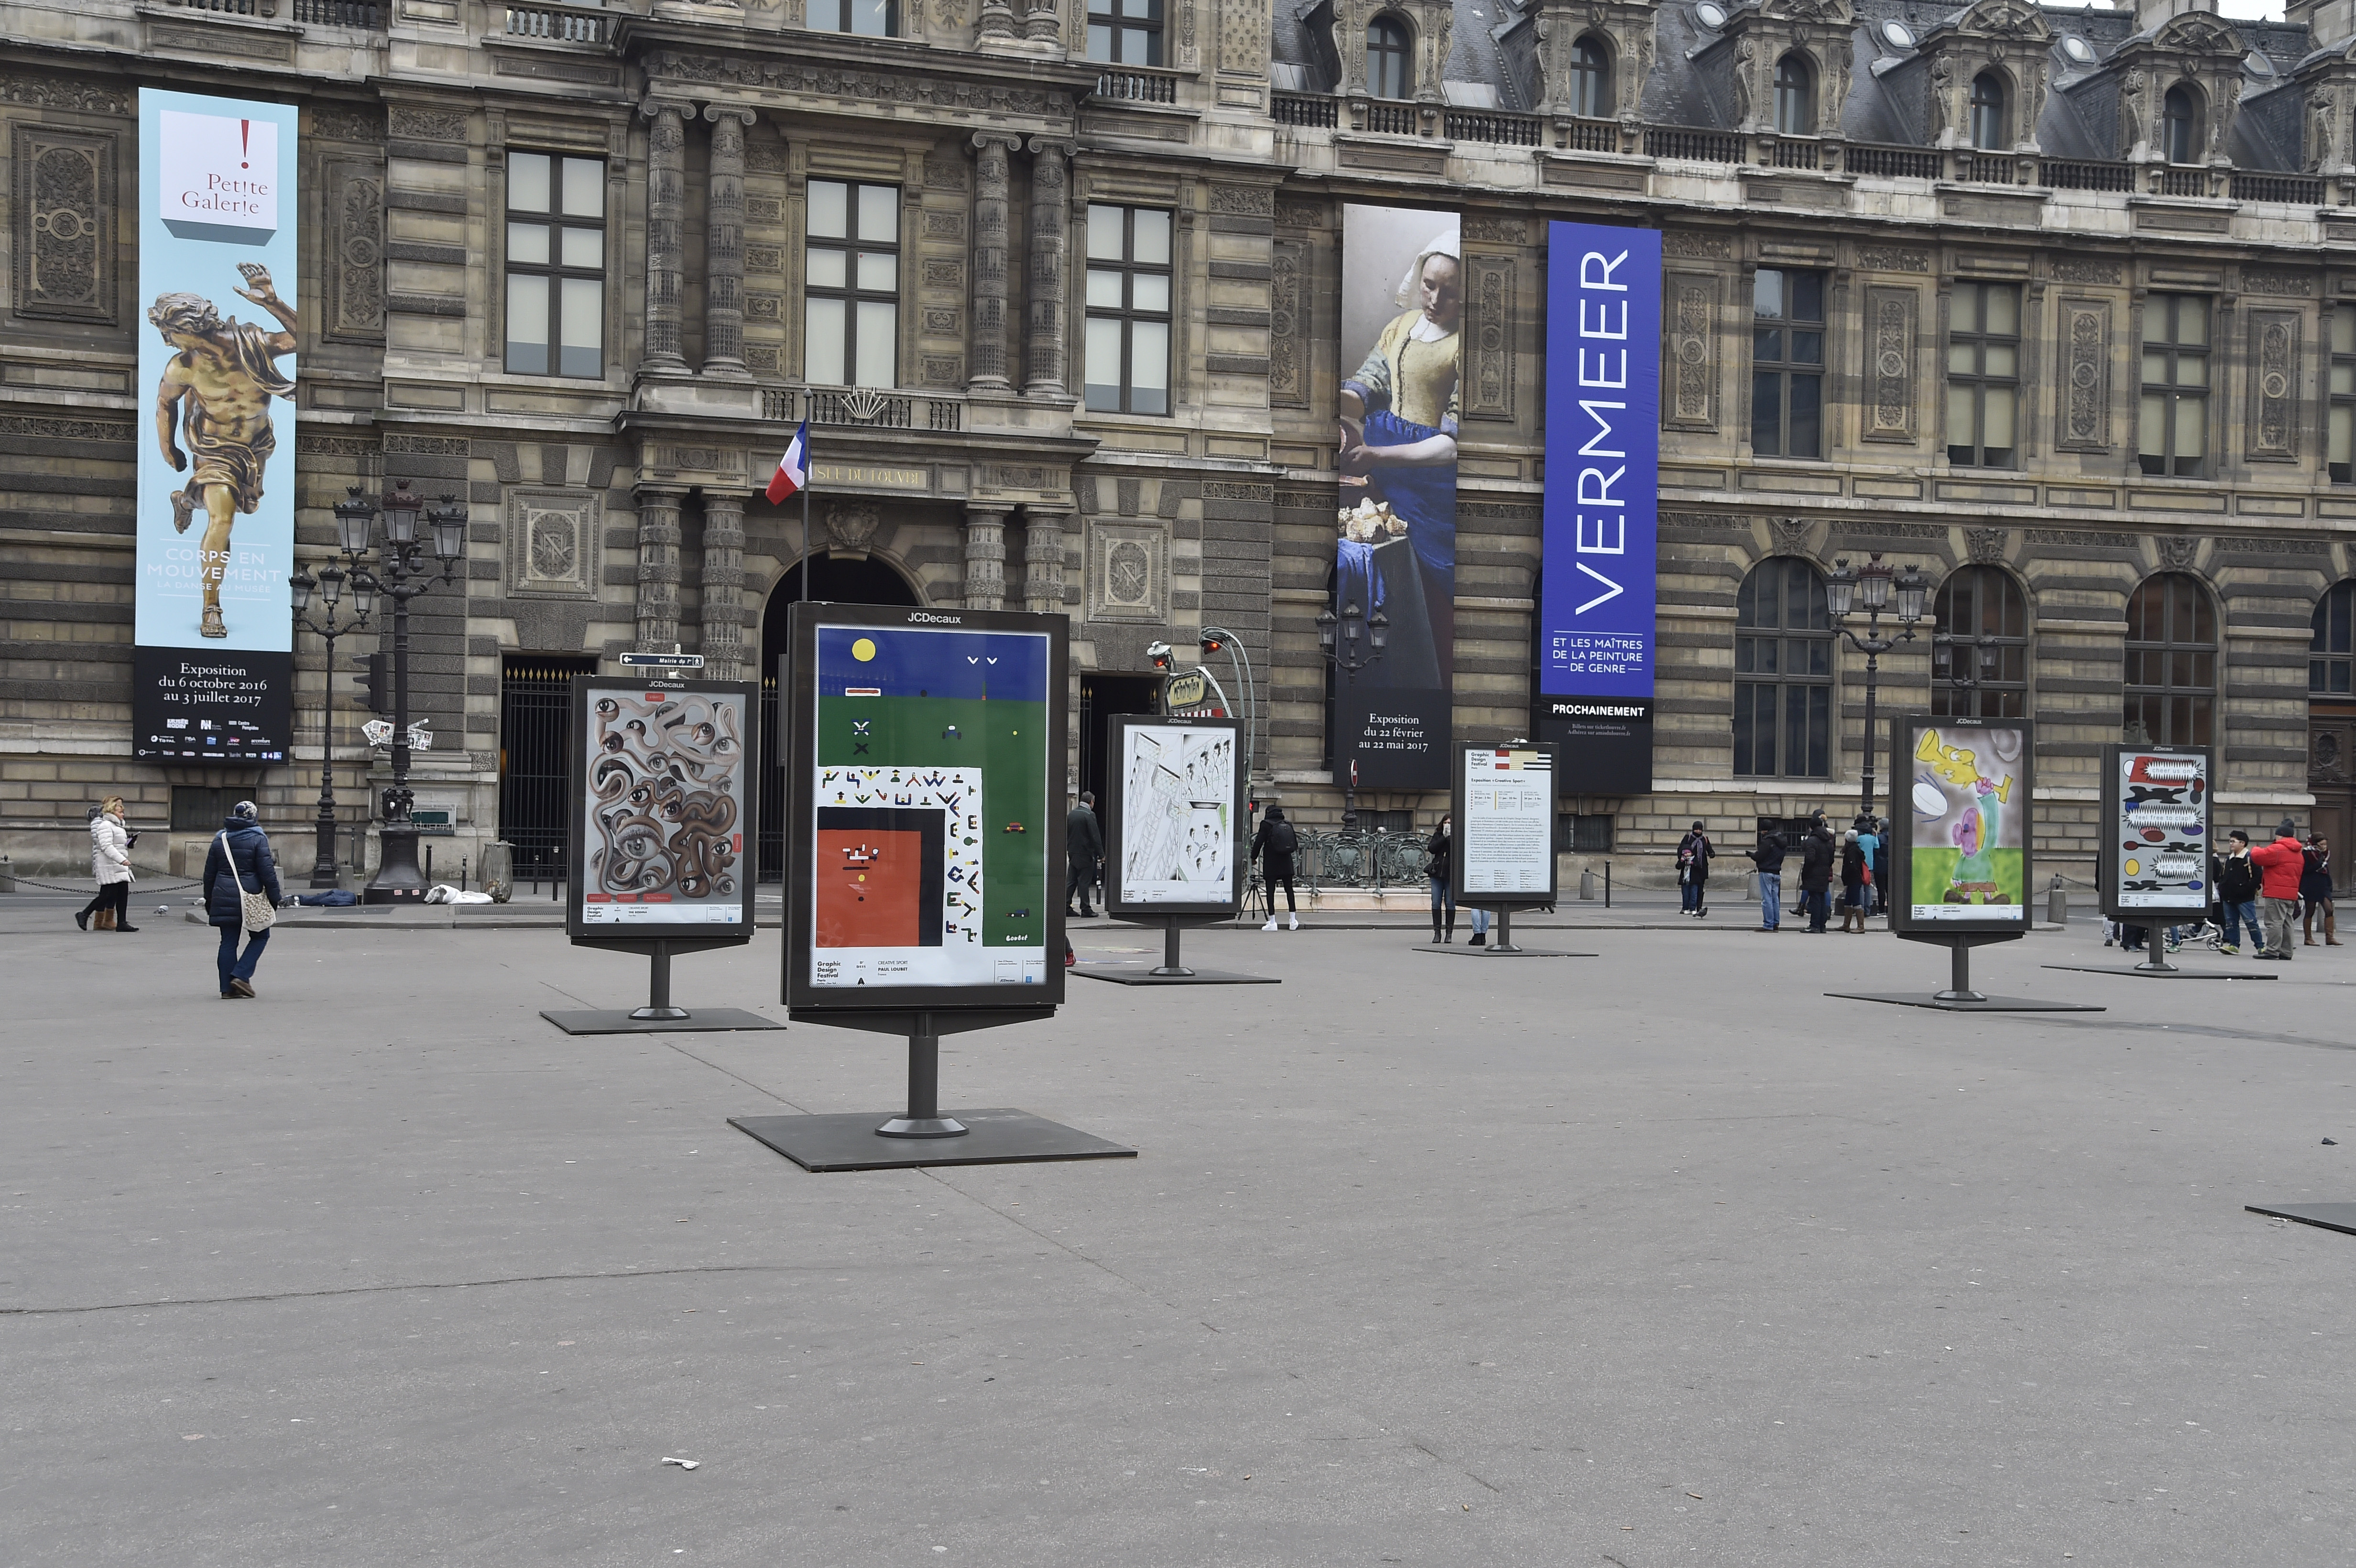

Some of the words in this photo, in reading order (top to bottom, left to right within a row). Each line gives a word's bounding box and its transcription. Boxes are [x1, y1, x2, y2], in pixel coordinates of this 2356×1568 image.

[1575, 249, 1627, 615] VERMEER
[849, 468, 866, 481] DU
[871, 470, 918, 484] LOUVRE
[166, 548, 230, 563] CORPS
[240, 552, 264, 565] EN
[147, 564, 281, 582] MOUVEMENT
[175, 582, 212, 590] DANSE
[235, 584, 271, 593] MUSÉE
[907, 612, 961, 624] JCDecaux
[1553, 638, 1567, 646] ET
[1571, 638, 1590, 648] LES
[1595, 638, 1643, 649] MAÎTRES
[1553, 650, 1567, 659] DE
[1571, 651, 1586, 660] LA
[1590, 651, 1643, 662] PEINTURE
[180, 663, 246, 677] Exposition
[1570, 663, 1584, 672] DE
[1589, 664, 1626, 674] GENRE
[159, 675, 175, 687] du
[179, 676, 186, 687] 6
[189, 677, 235, 689] octobre
[239, 679, 267, 690] 2016
[164, 692, 179, 701] au
[182, 694, 189, 705] 3
[193, 691, 230, 704] juillet
[233, 695, 262, 707] 2017
[1553, 704, 1645, 717] PROCHAINEMENT
[1369, 713, 1419, 726] Exposition
[1364, 727, 1376, 736] du
[1393, 727, 1424, 738] février
[1386, 740, 1404, 749] mai
[1407, 743, 1429, 752] 2017
